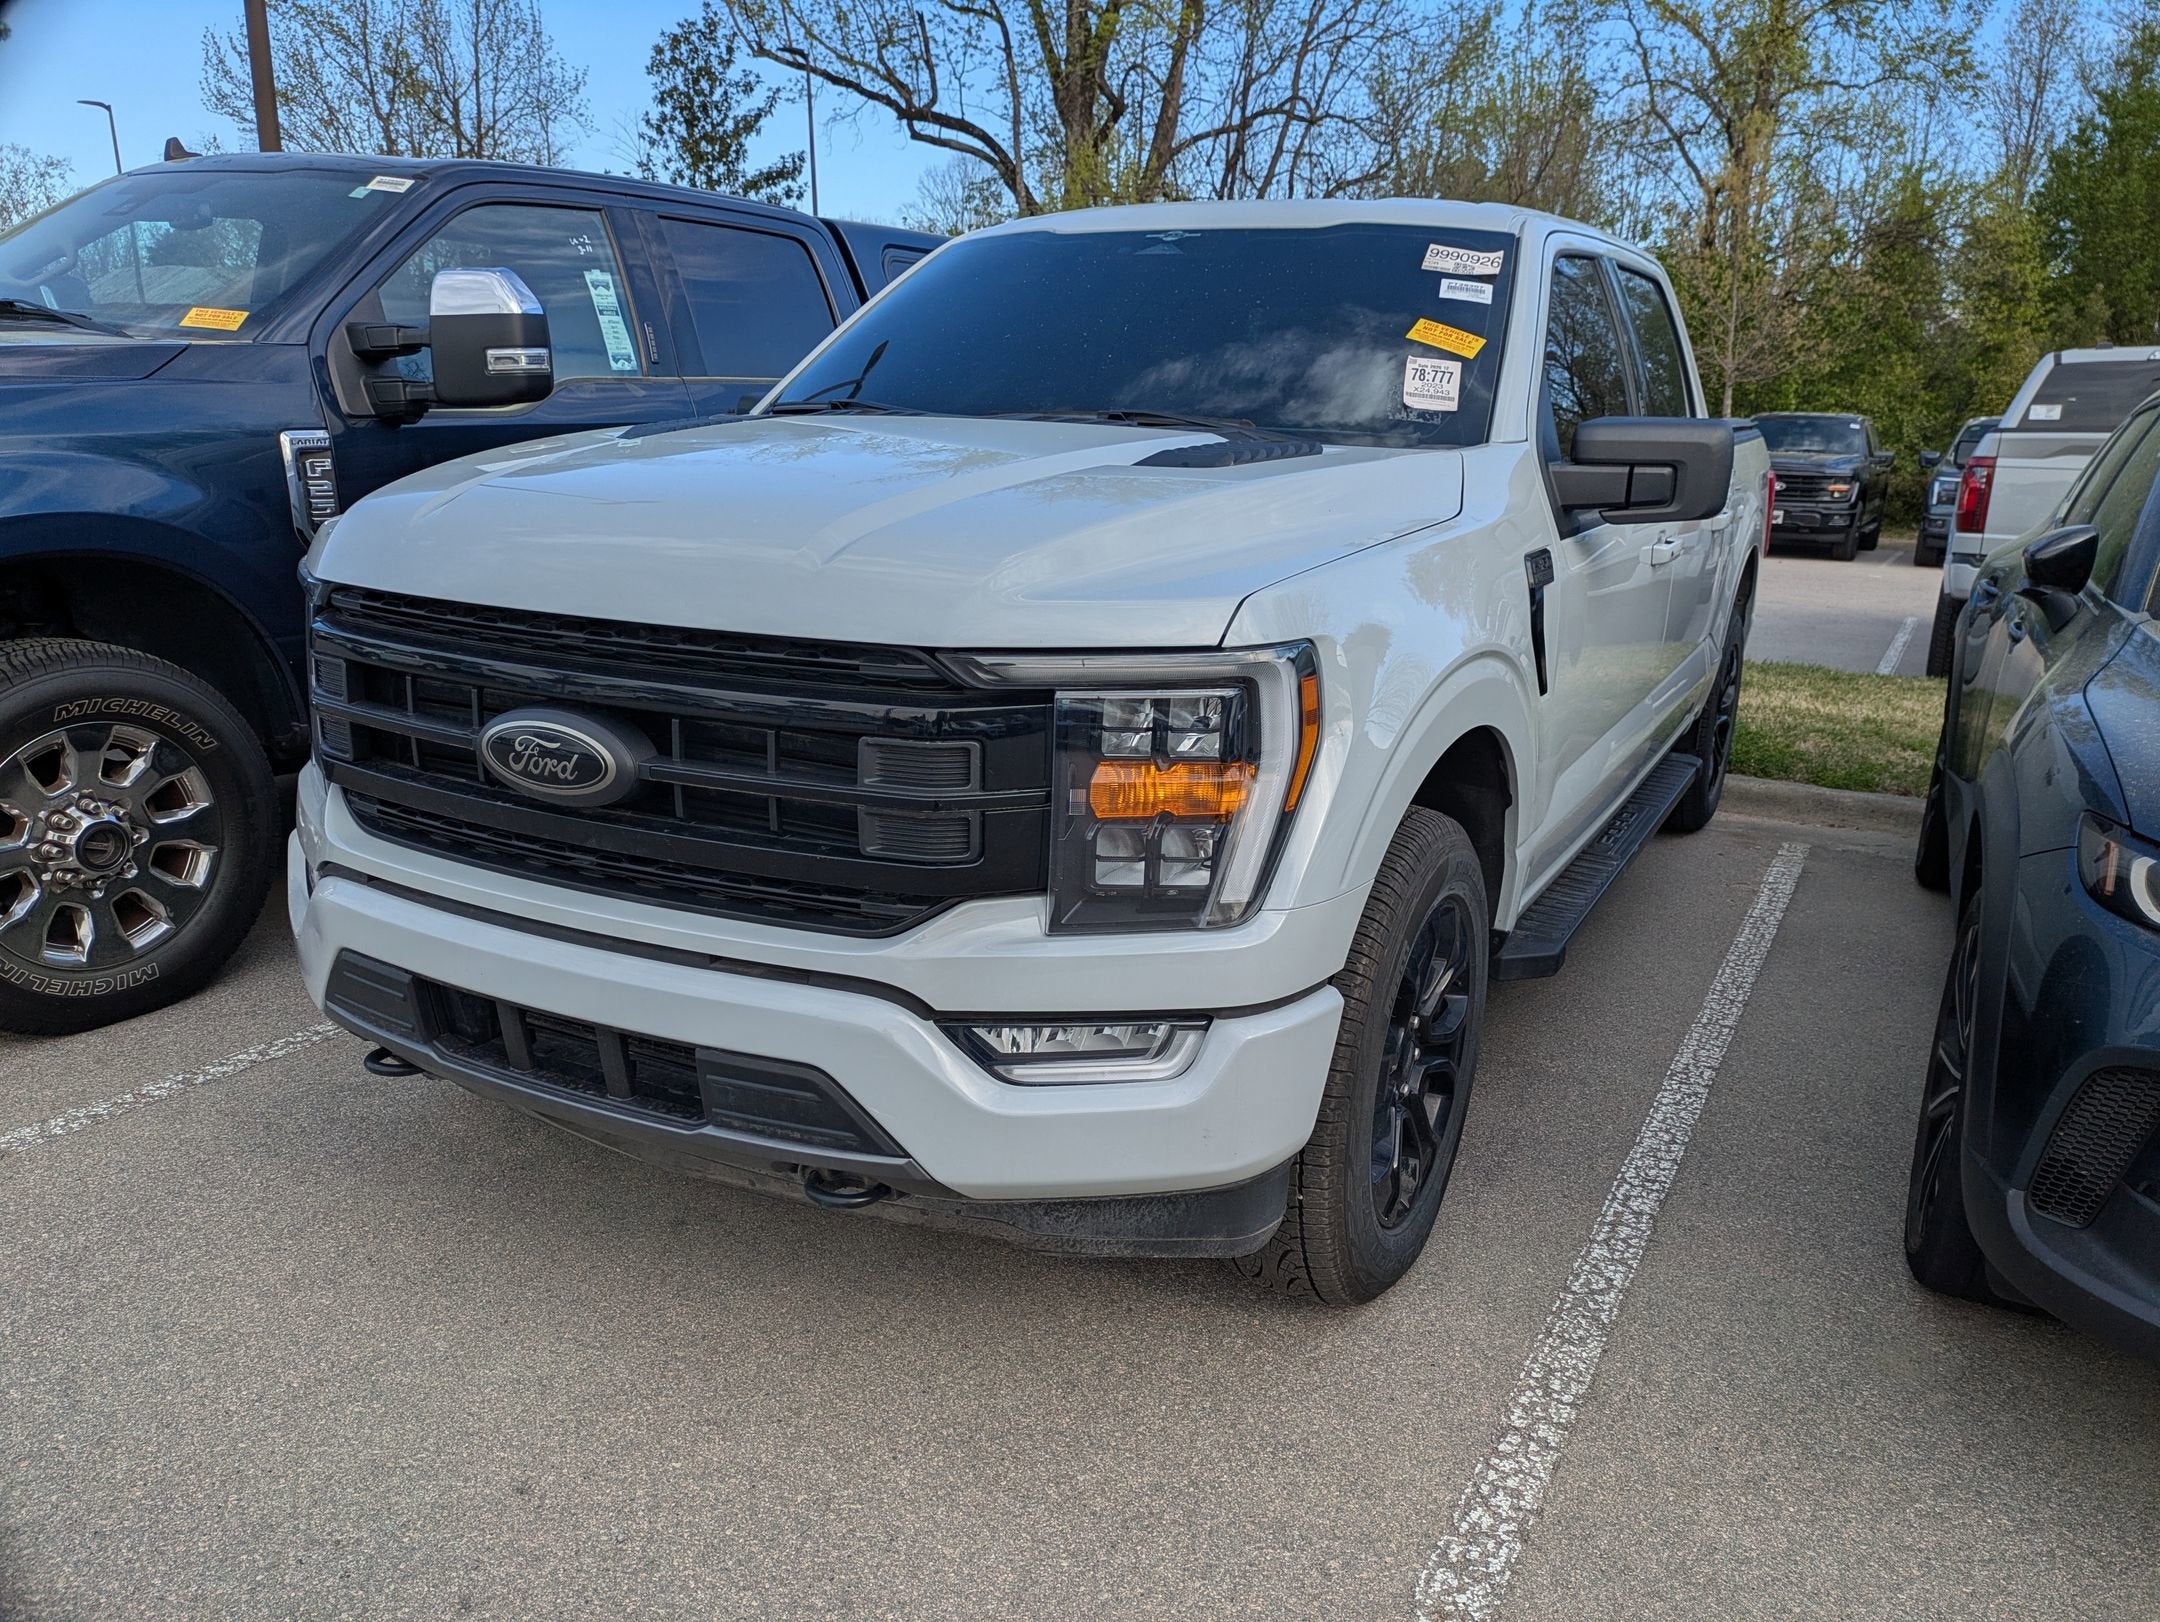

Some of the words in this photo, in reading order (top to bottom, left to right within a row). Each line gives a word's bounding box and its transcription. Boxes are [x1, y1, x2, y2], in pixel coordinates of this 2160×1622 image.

[1428, 247, 1502, 269] 9990926
[1422, 325, 1437, 333] NOT
[1438, 329, 1453, 338] FOR
[1456, 334, 1474, 345] SALE
[1423, 320, 1440, 329] THIS
[1441, 325, 1470, 339] VEHICLE
[1411, 368, 1454, 385] 78:777
[1421, 381, 1444, 390] 2023
[54, 698, 218, 750] MICHELIN
[508, 735, 579, 781] Ford
